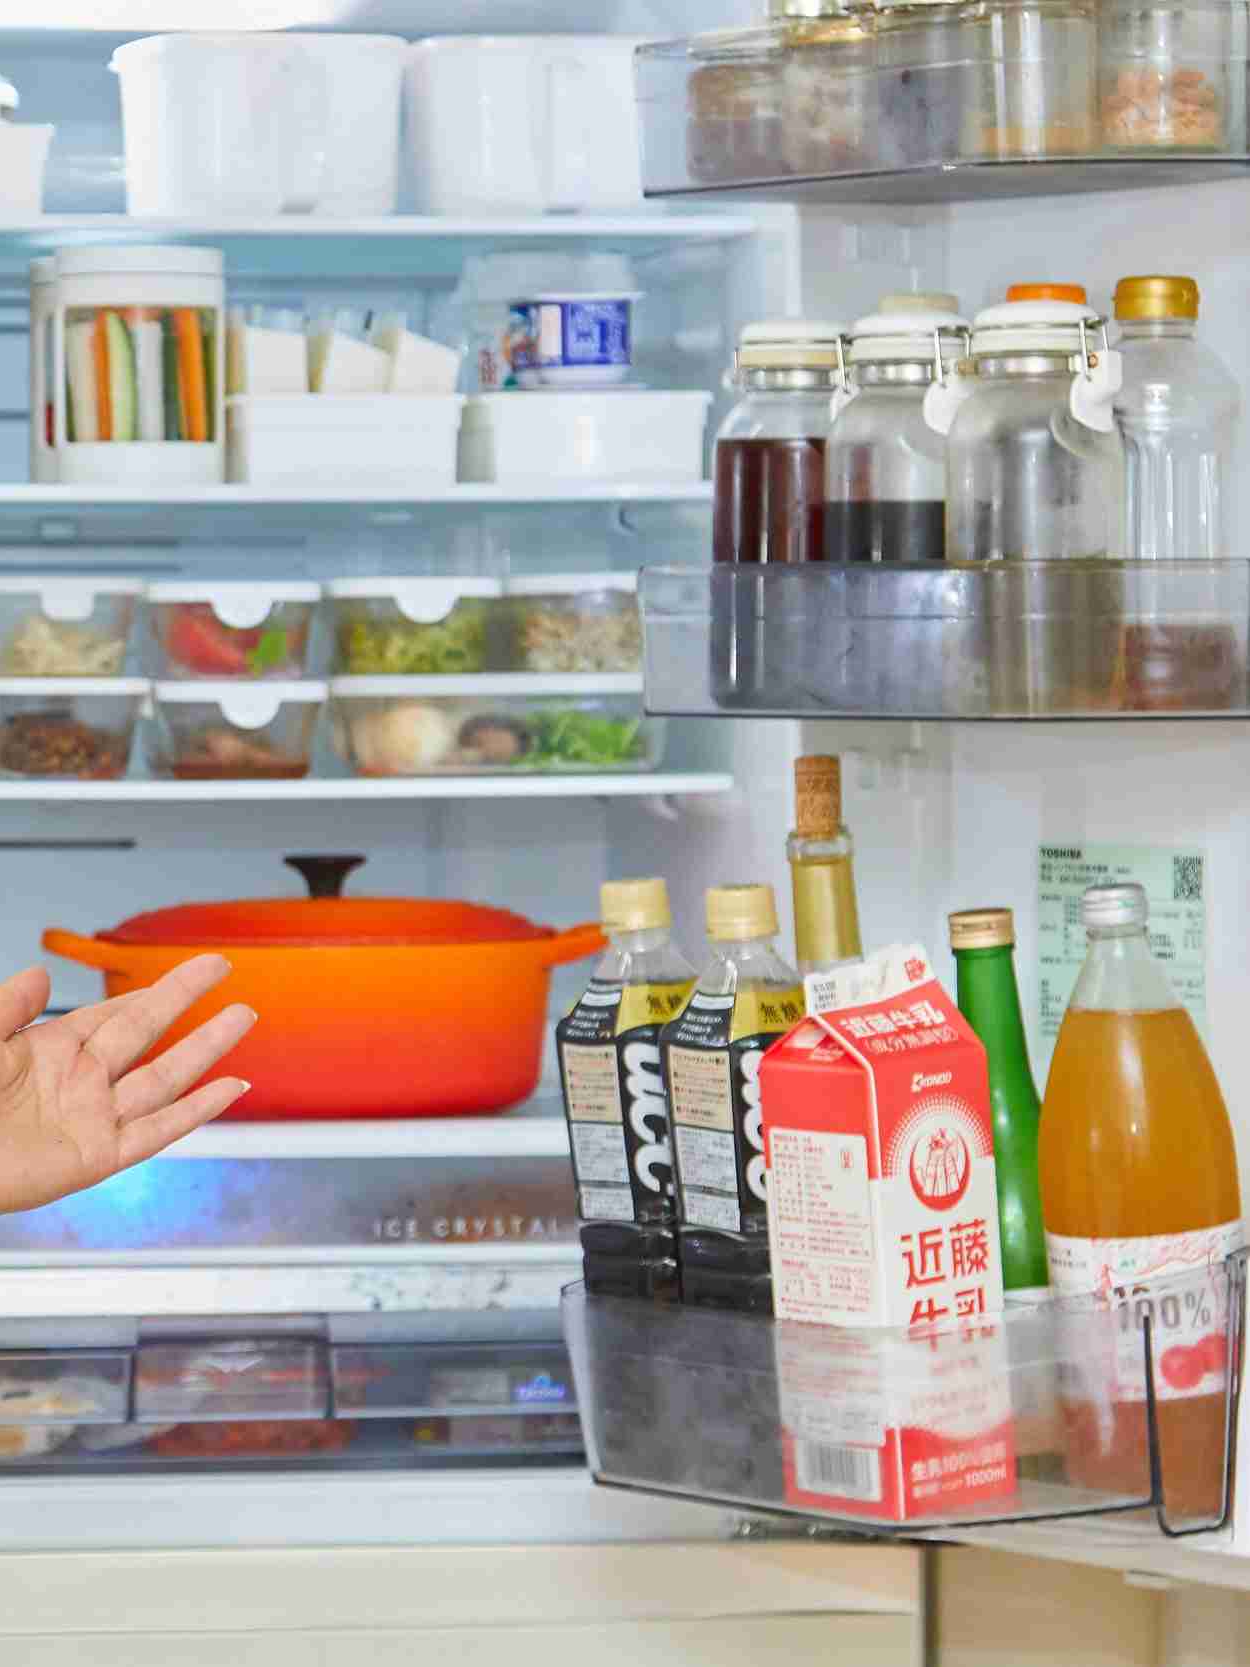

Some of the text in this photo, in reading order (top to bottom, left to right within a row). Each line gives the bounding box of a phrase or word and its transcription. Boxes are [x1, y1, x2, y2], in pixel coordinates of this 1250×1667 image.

[1039, 847, 1082, 860] TOSHIBA
[900, 1218, 987, 1288] 近藤
[909, 1287, 997, 1352] 牛乳
